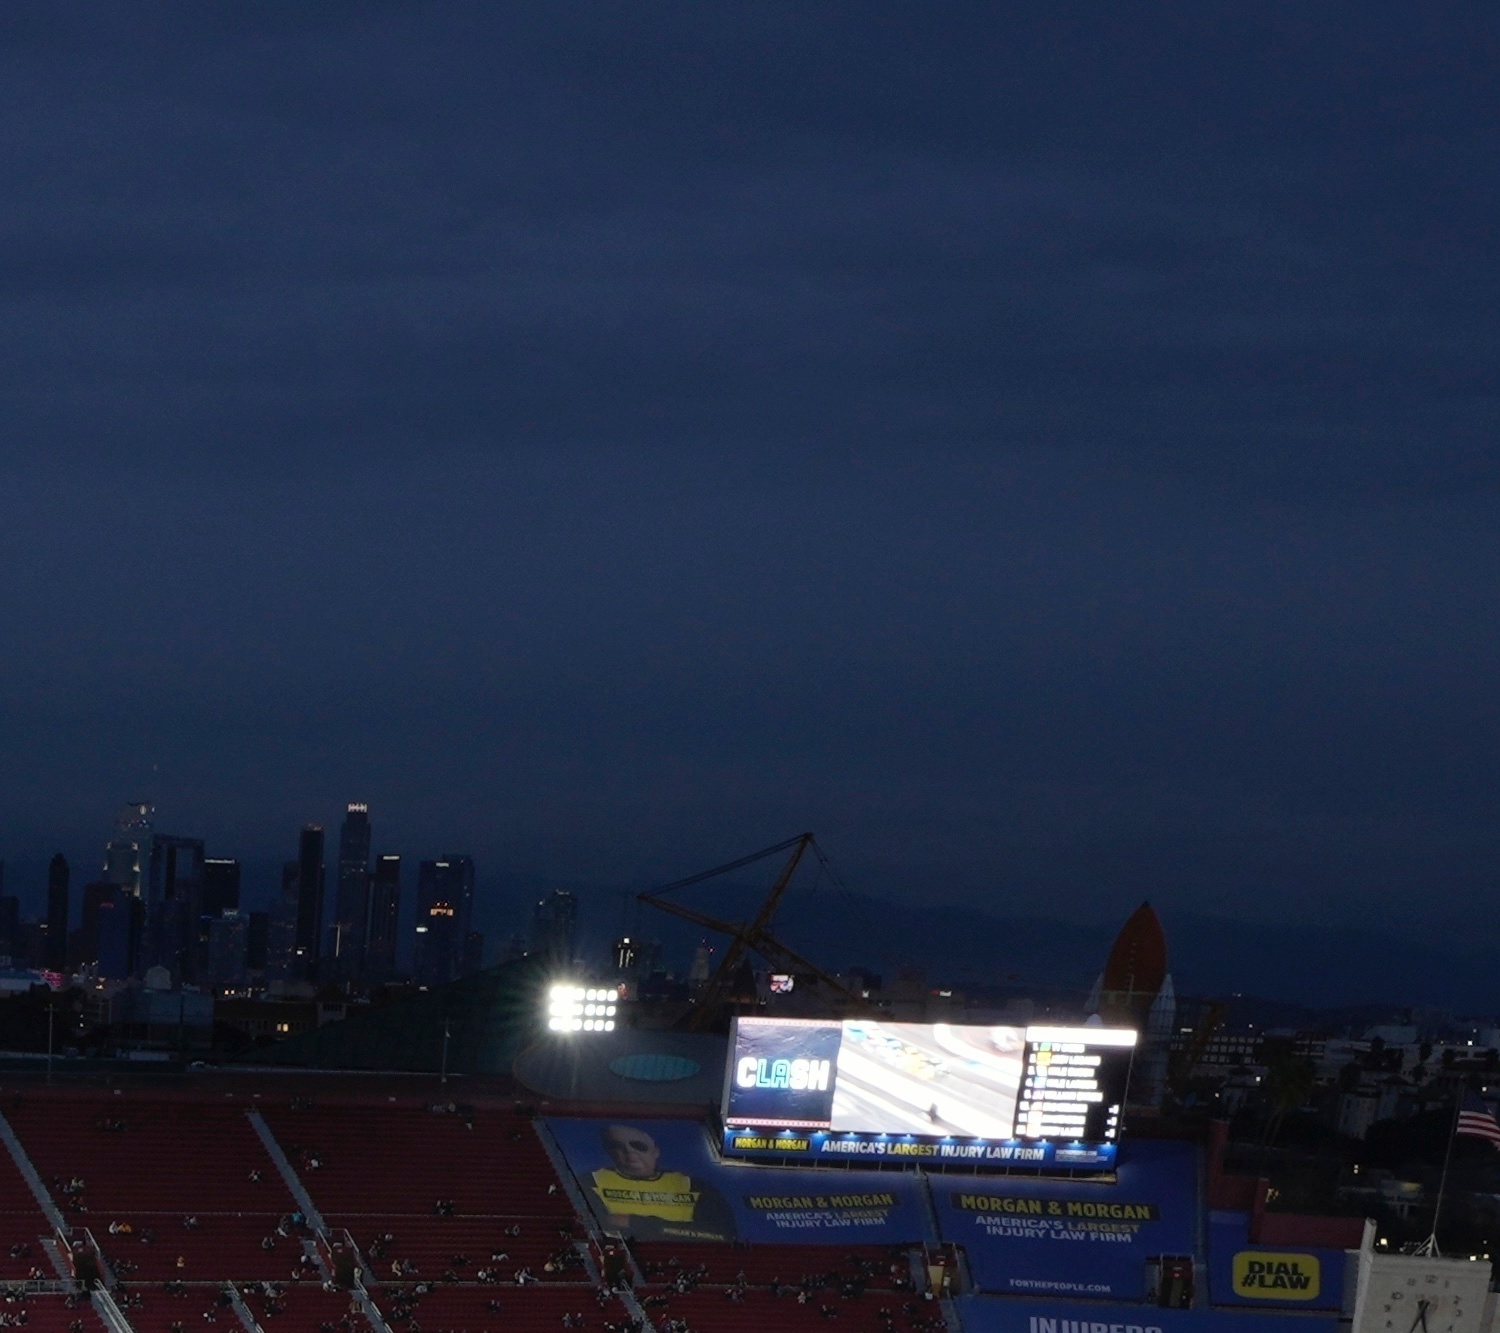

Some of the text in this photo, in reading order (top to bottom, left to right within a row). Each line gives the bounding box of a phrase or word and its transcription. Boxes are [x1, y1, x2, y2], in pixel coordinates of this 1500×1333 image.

[737, 1056, 830, 1091] CLASH
[821, 1140, 886, 1155] AMERICA'S
[887, 1142, 938, 1157] LARGEST
[941, 1144, 984, 1159] INJURY
[986, 1146, 1012, 1159] LAW
[1014, 1147, 1044, 1161] FIRM
[960, 1195, 1150, 1221] MORGAN & MORGAN
[775, 1216, 885, 1229] INJURY LAW FIRM
[975, 1215, 1139, 1234] AMERICA'S LARGEST
[986, 1225, 1132, 1243] INJURY LAW FIRM
[1246, 1260, 1303, 1276] DIAL
[1008, 1277, 1111, 1293] FORTHEPEOPLE.COM
[1241, 1273, 1311, 1291] #LAW
